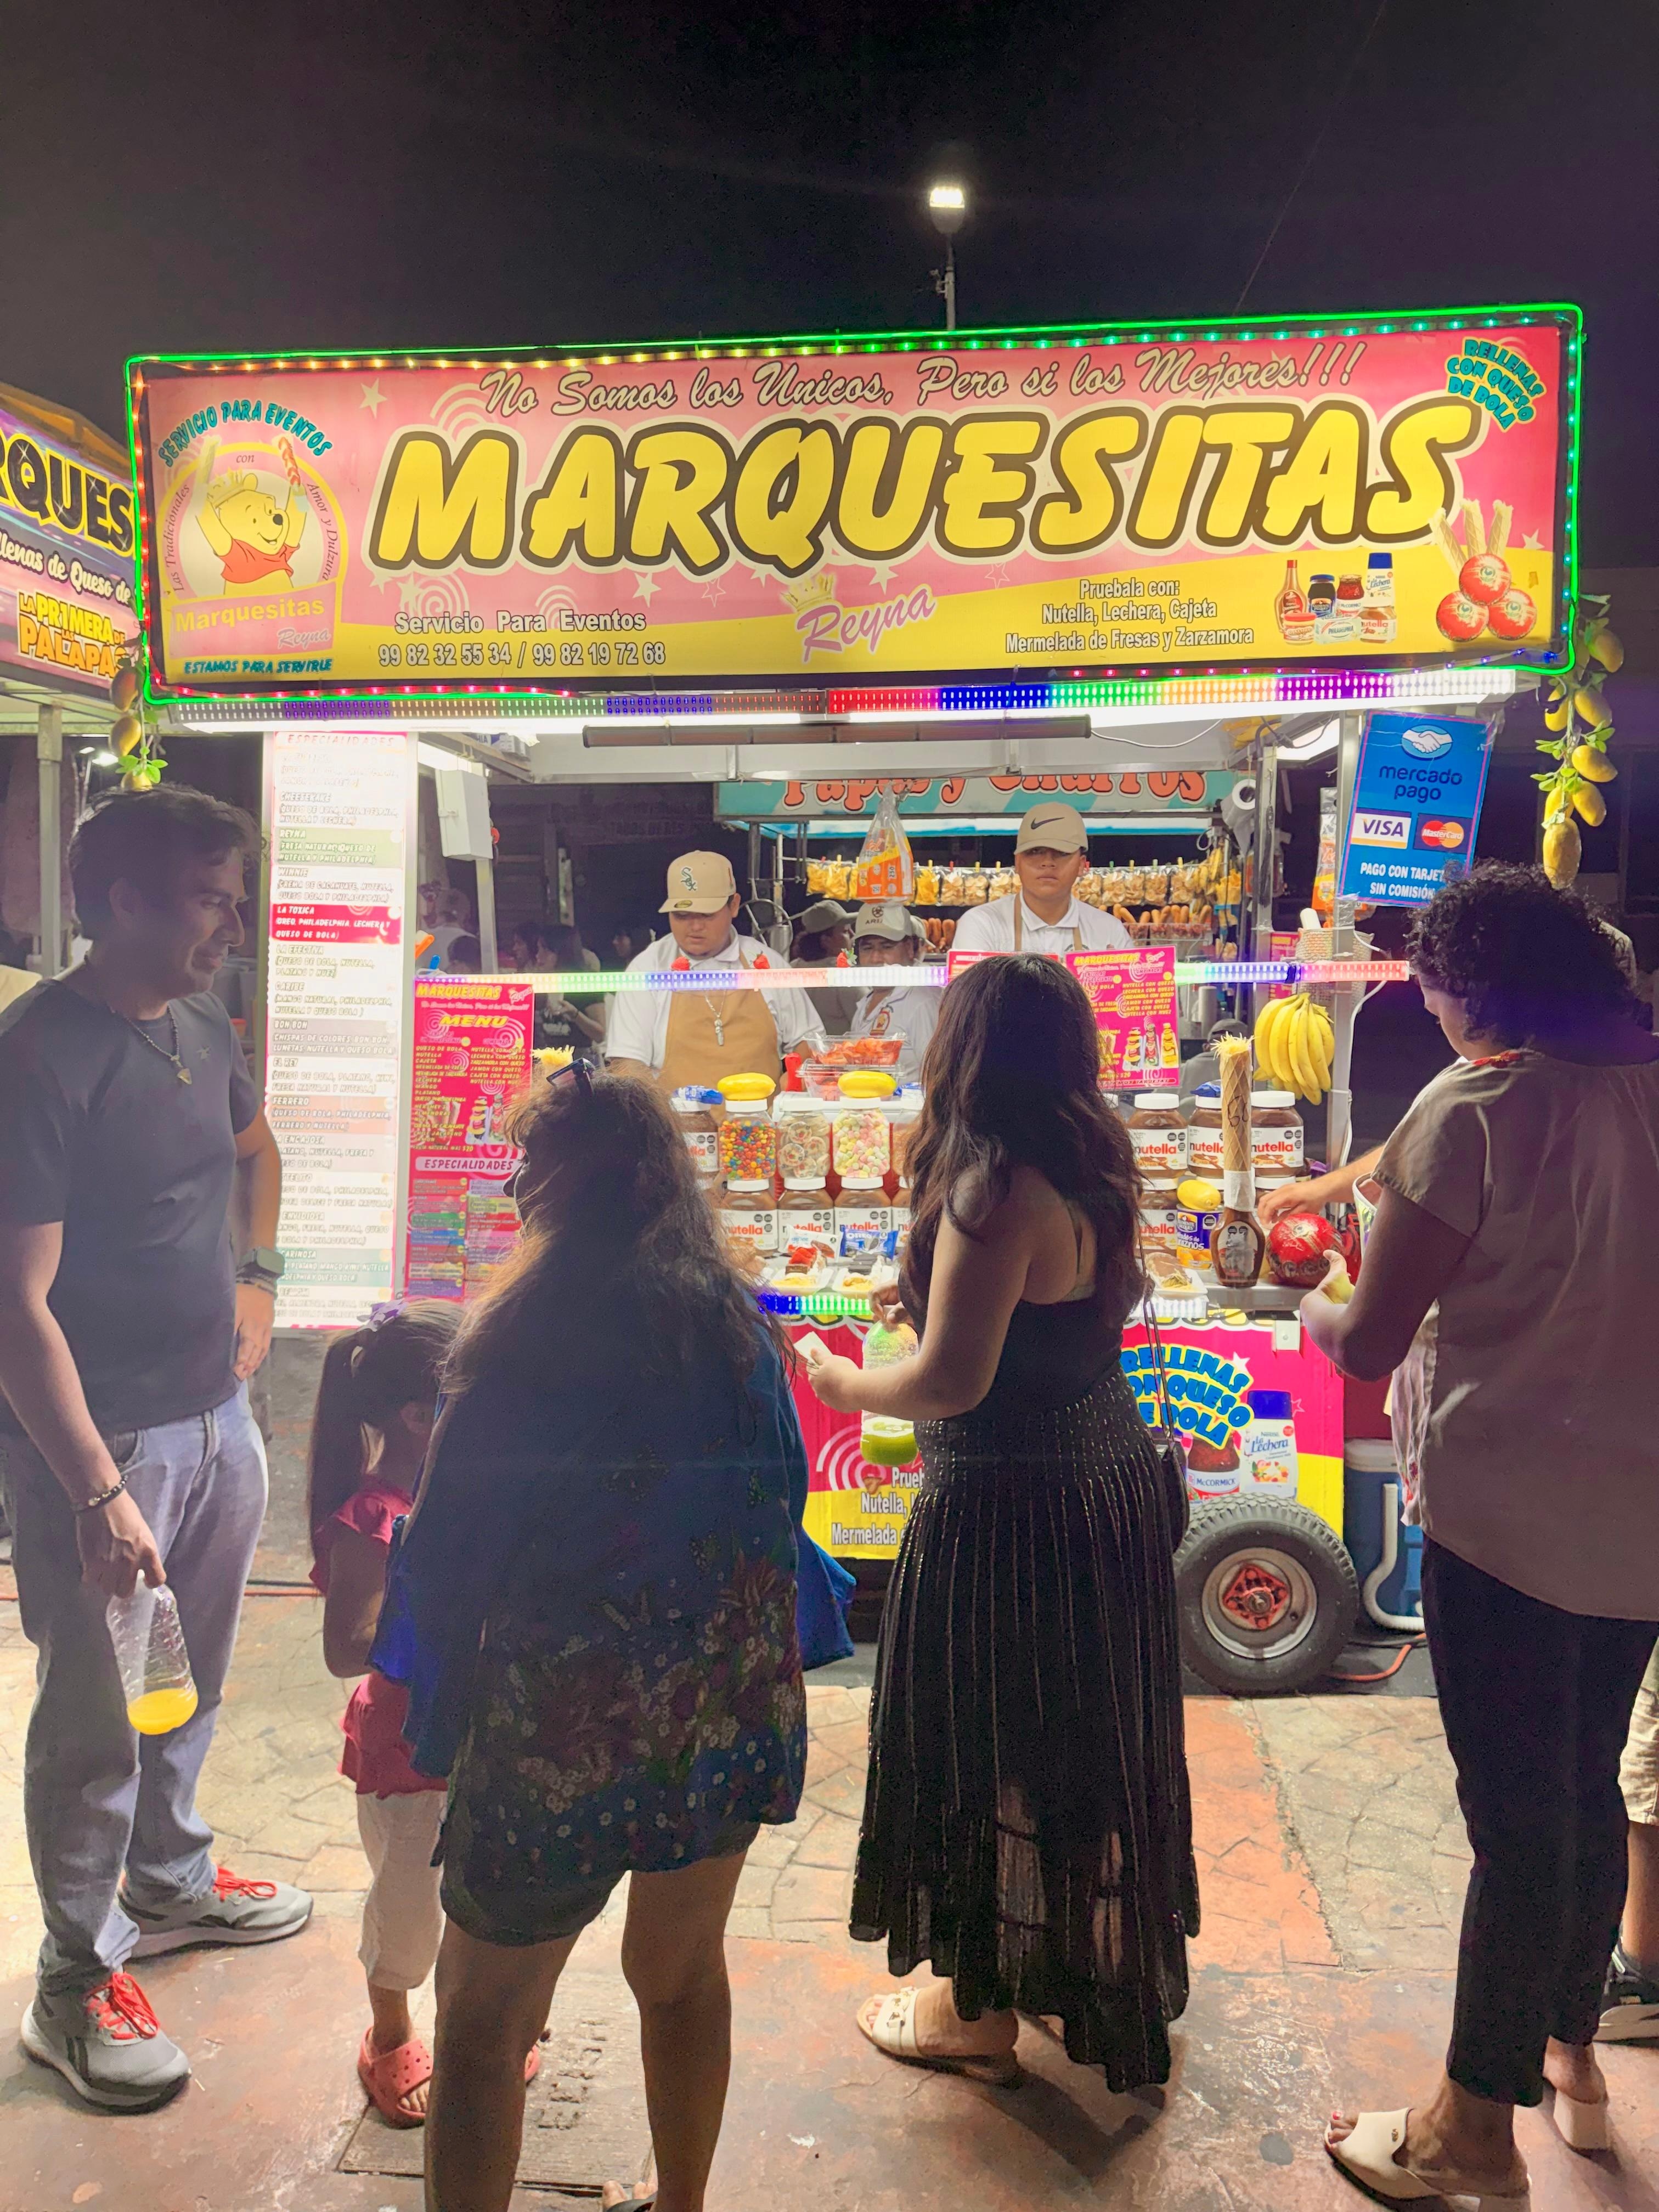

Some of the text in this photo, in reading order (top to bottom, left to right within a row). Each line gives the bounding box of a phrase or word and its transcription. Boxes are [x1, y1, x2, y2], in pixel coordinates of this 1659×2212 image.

[479, 341, 1367, 417] No Somos los Unicos, Pero si los Mejores!!!
[1465, 339, 1544, 397] RELLENAS
[1447, 357, 1534, 421] CON QUESO
[1448, 376, 1516, 430] DE BOLA
[158, 399, 332, 467] SERVICIO PARA EVENTOS
[236, 454, 255, 463] con
[369, 396, 1481, 577] MARQUESITAS
[164, 485, 189, 591] Las Tradicionales
[307, 483, 328, 512] Amor
[323, 529, 338, 580] Dulzura
[48, 553, 68, 581] de
[70, 559, 112, 594] Queso
[115, 580, 132, 604] de
[1079, 577, 1180, 600] Pruebala con:
[19, 592, 36, 615] LA
[1042, 598, 1217, 626] Nutella, Lechera, Cajeta
[176, 599, 324, 632] Marquesitas
[394, 608, 647, 634] Servicio Para Eventos
[797, 588, 936, 662] Reyna
[61, 629, 75, 641] LAS
[277, 628, 330, 650] Reyna
[1006, 626, 1254, 653] Mermelada de Fresas y Zarzamora
[378, 641, 666, 668] 99 82 32 55 34 / 99 82 19 72 68
[184, 659, 332, 674] ESTAMOS PARA SERVIRLE
[1379, 765, 1463, 785] mercado
[1394, 785, 1441, 803] pago
[1361, 818, 1404, 837] VISA
[1421, 828, 1463, 840] MasterCard
[1360, 862, 1447, 882] PAGO CON TARJET
[1370, 882, 1435, 900] SIN COMISIÓN
[277, 906, 287, 914] LA
[1074, 954, 1140, 966] MARQUESITAS
[417, 984, 501, 1000] MARQUESITAS
[439, 1015, 509, 1028] MENU
[273, 1097, 309, 1106] FERRERO
[425, 1159, 514, 1170] ESPECIALIDADES
[1120, 1346, 1250, 1393] RELLENAS
[1167, 1374, 1250, 1427] QUESO
[1251, 1439, 1288, 1453] Lechera
[1197, 1478, 1235, 1486] McCORMICK
[861, 1493, 908, 1516] Nutella,
[831, 1523, 898, 1545] Mermelada
